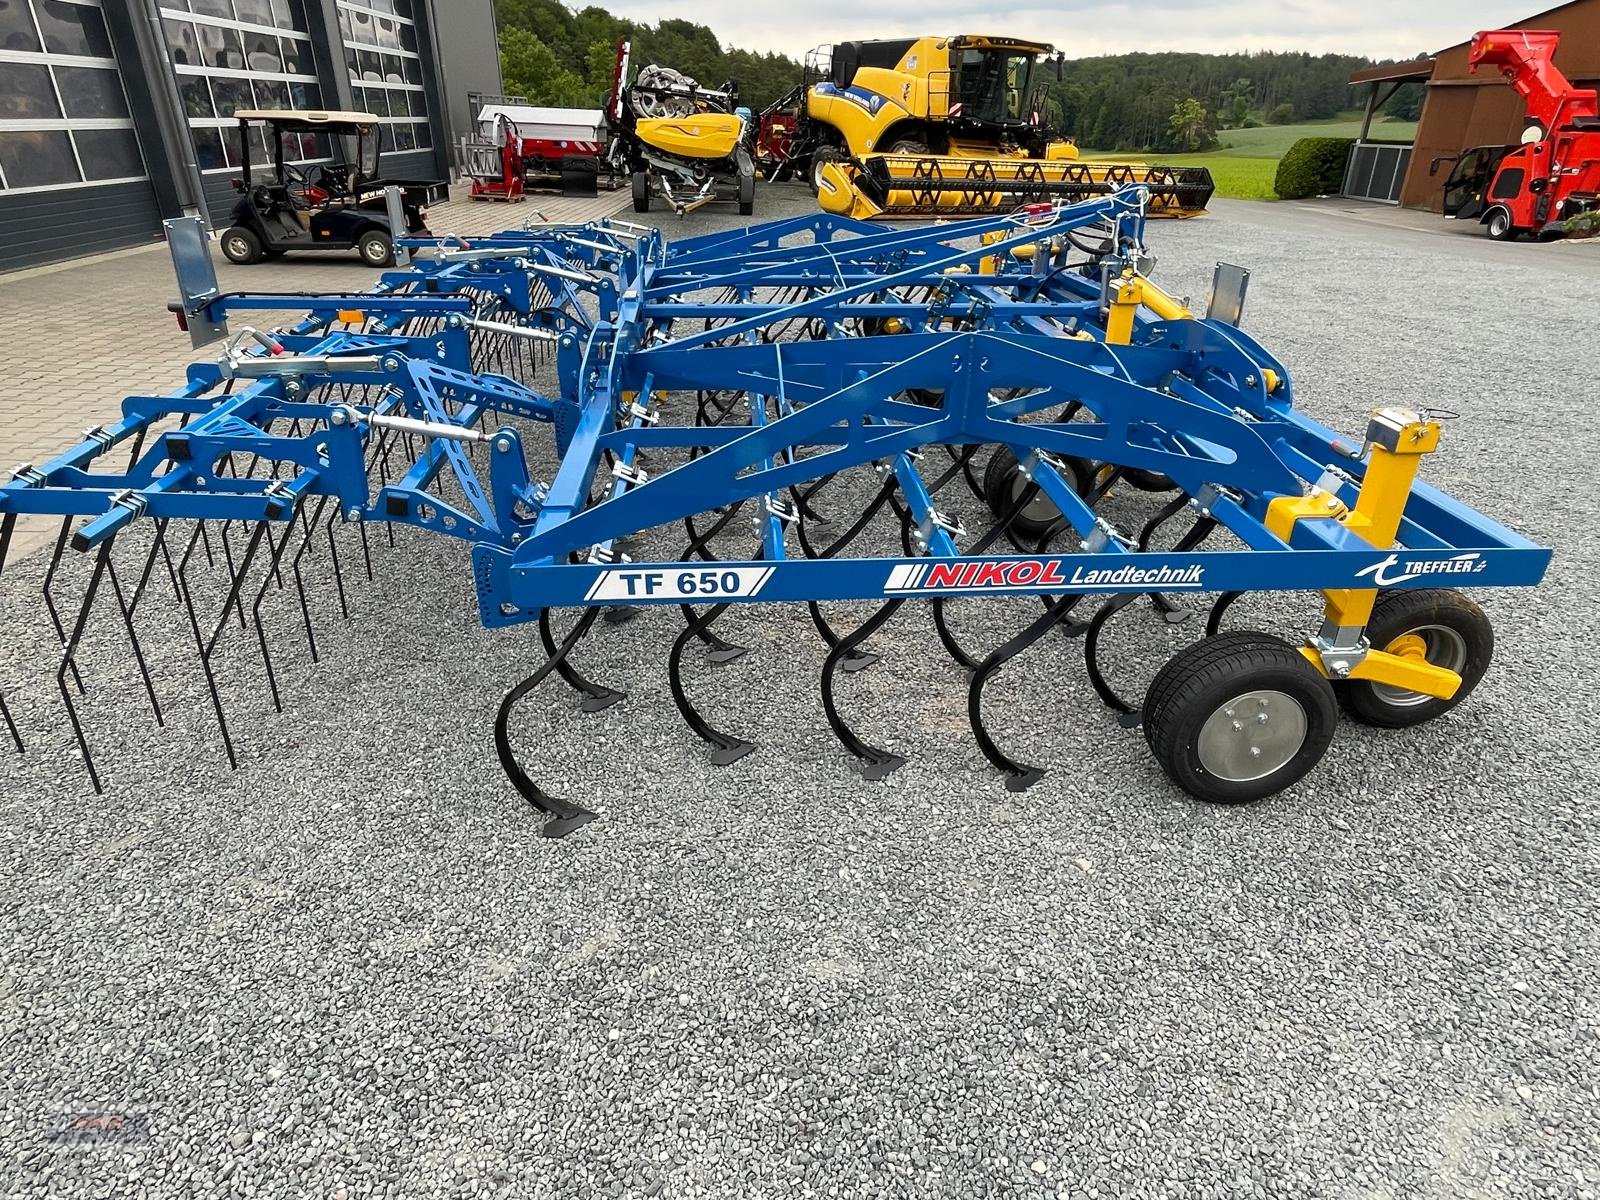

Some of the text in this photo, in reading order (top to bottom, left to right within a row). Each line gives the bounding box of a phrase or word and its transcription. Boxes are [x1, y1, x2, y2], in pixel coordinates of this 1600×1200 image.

[361, 191, 375, 199] NEW
[925, 561, 1205, 587] NIKOL Landtechnik
[1405, 560, 1474, 574] TREFFLER
[619, 571, 741, 595] TF 650
